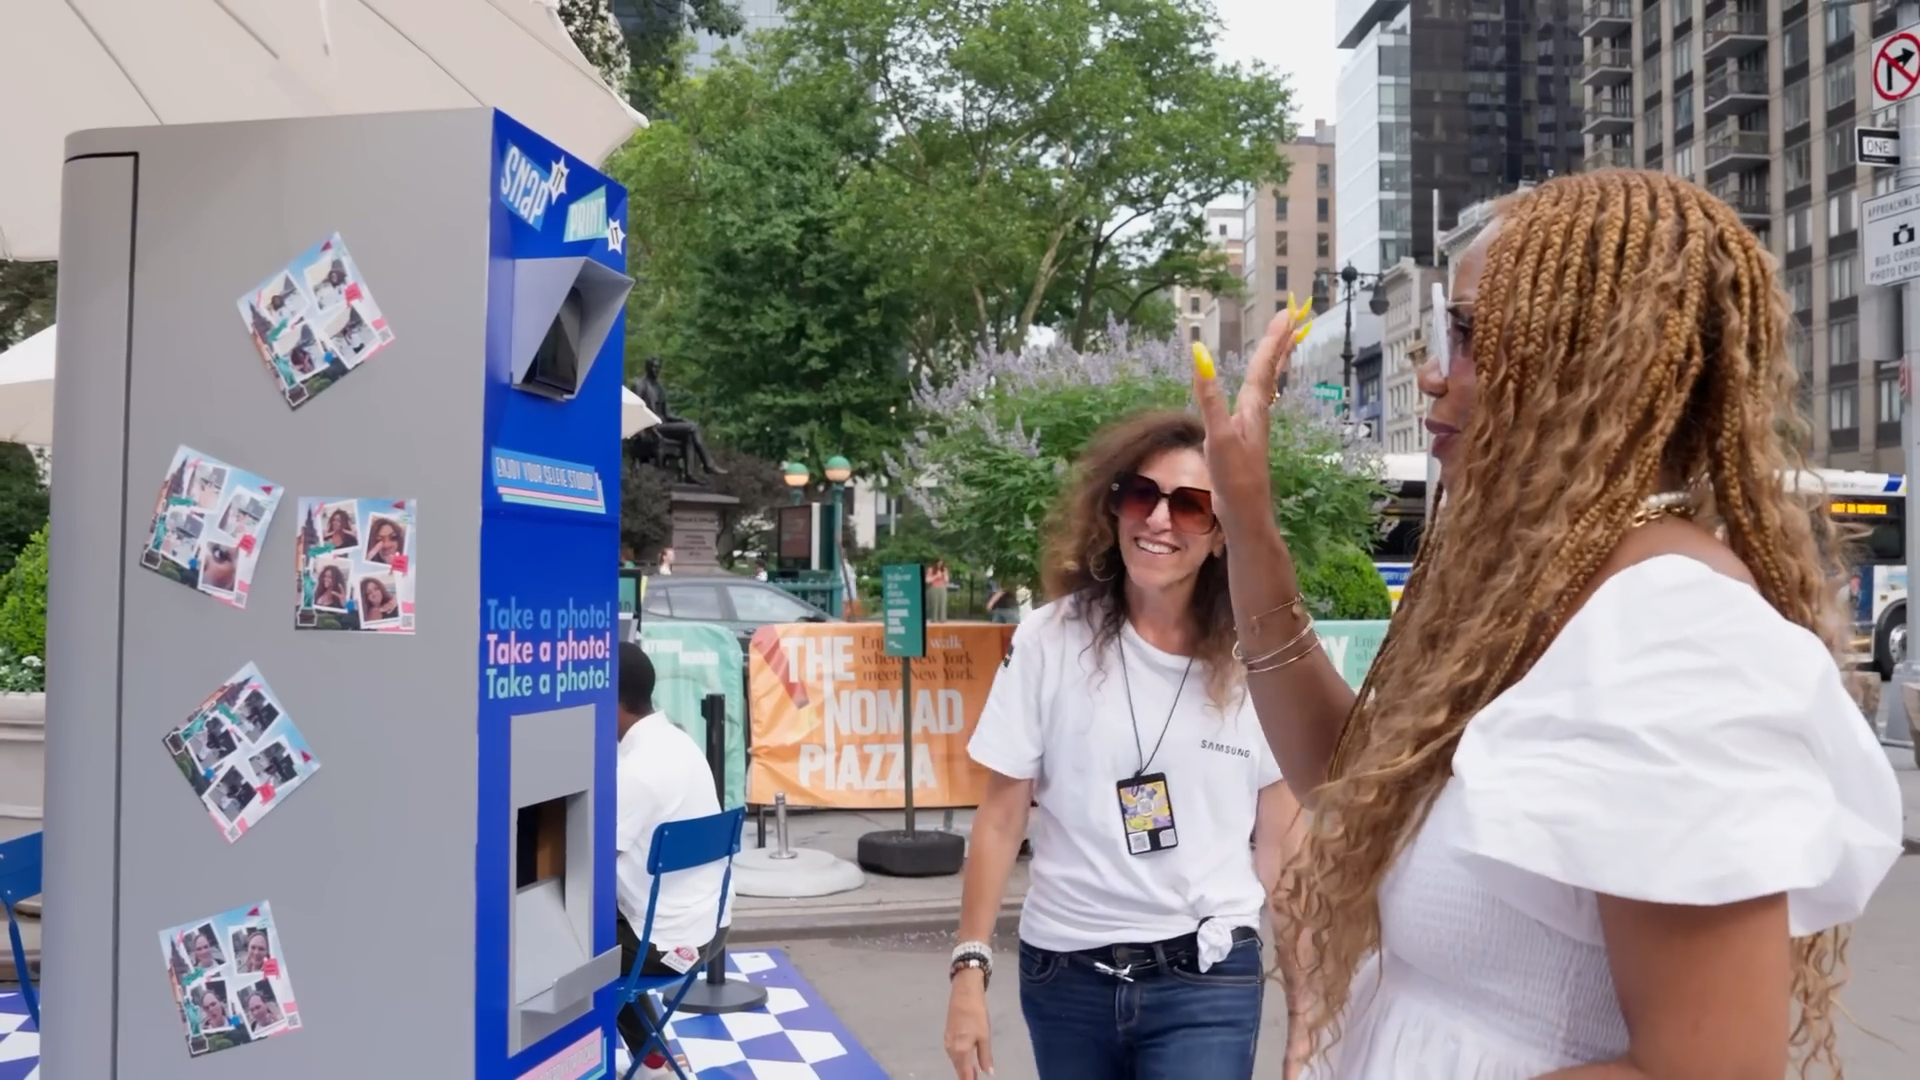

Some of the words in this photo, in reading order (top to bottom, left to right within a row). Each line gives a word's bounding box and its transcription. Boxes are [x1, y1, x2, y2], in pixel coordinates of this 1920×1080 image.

[1866, 139, 1890, 154] ONE
[1868, 195, 1913, 218] APPROACHING
[1870, 267, 1896, 281] PHOTO
[1875, 254, 1891, 267] BUS
[487, 596, 533, 630] Take
[540, 608, 551, 629] a
[557, 597, 611, 639] photo!
[487, 630, 533, 665] Take
[539, 641, 551, 662] a
[556, 630, 610, 671] photo!
[780, 636, 855, 683] THE
[943, 650, 974, 665] York
[486, 664, 533, 700] Take
[539, 673, 550, 695] a
[556, 660, 610, 702] photo!
[824, 688, 964, 735] NOMAD
[1201, 739, 1251, 759] SAMSUNG
[798, 743, 938, 791] PIAZZA
